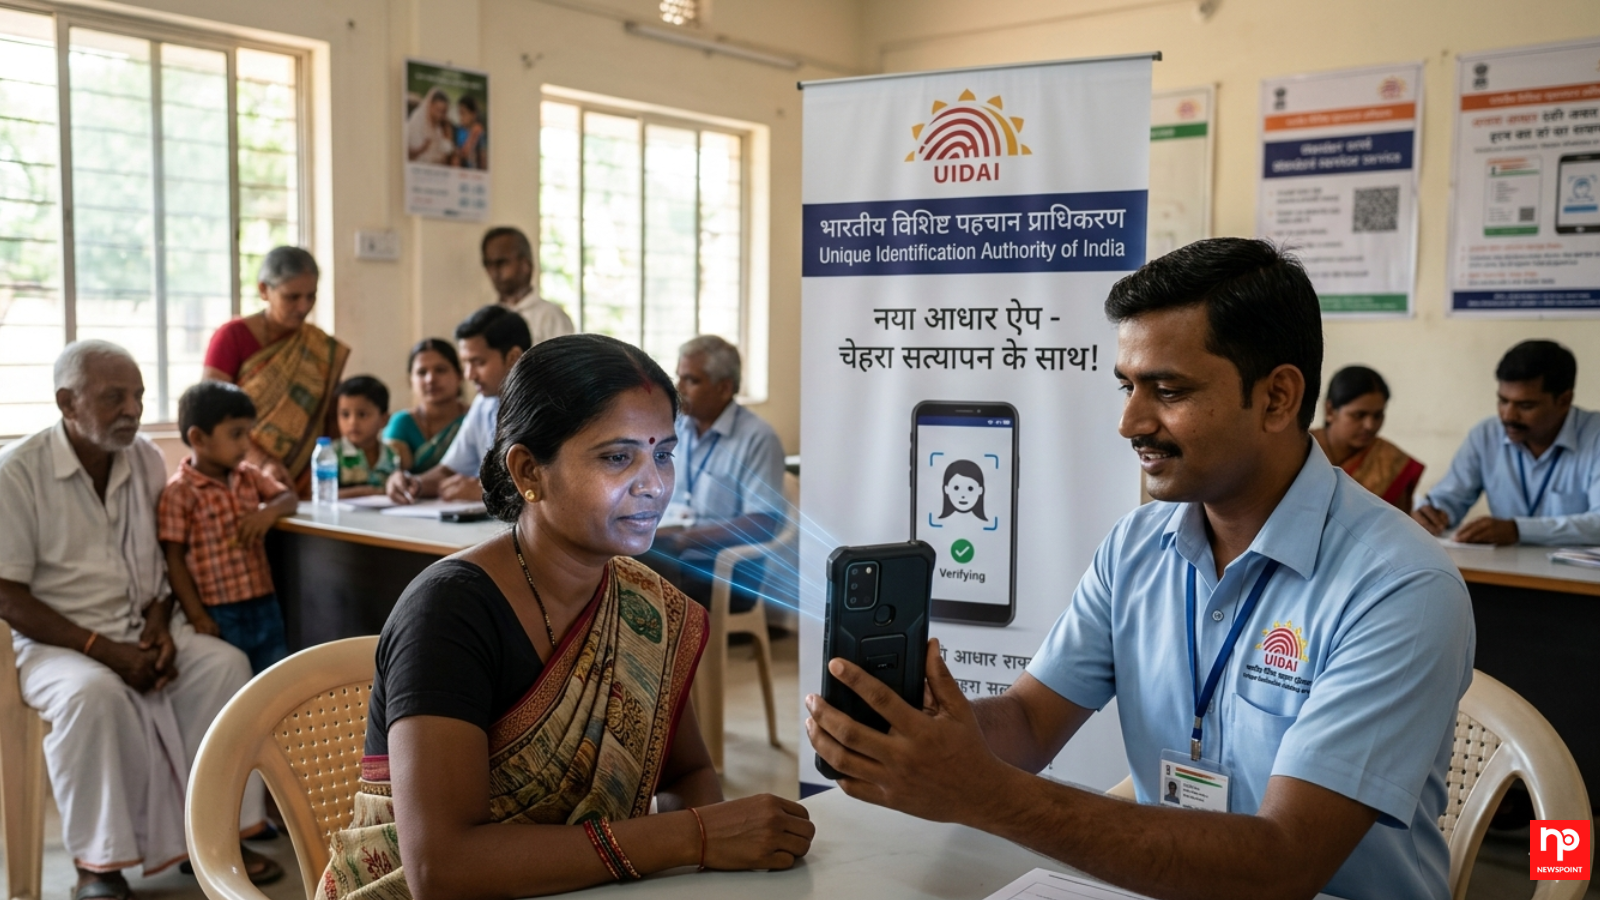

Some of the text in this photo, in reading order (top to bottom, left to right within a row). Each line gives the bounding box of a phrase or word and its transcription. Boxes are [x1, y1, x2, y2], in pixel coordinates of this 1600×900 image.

[934, 162, 1000, 183] UIDAI
[820, 204, 1126, 238] भारतीय विशिष्ट पहचान प्राधिकरण
[819, 239, 1125, 266] Unique Identification Authority of India
[874, 307, 916, 331] नया
[924, 307, 998, 331] आधार
[1006, 298, 1043, 336] ऐप
[839, 338, 1098, 372] चेहरा सत्यापन के साथ!
[939, 568, 985, 584] Verifying
[954, 650, 997, 667] आधार
[1265, 653, 1298, 672] UIDAI
